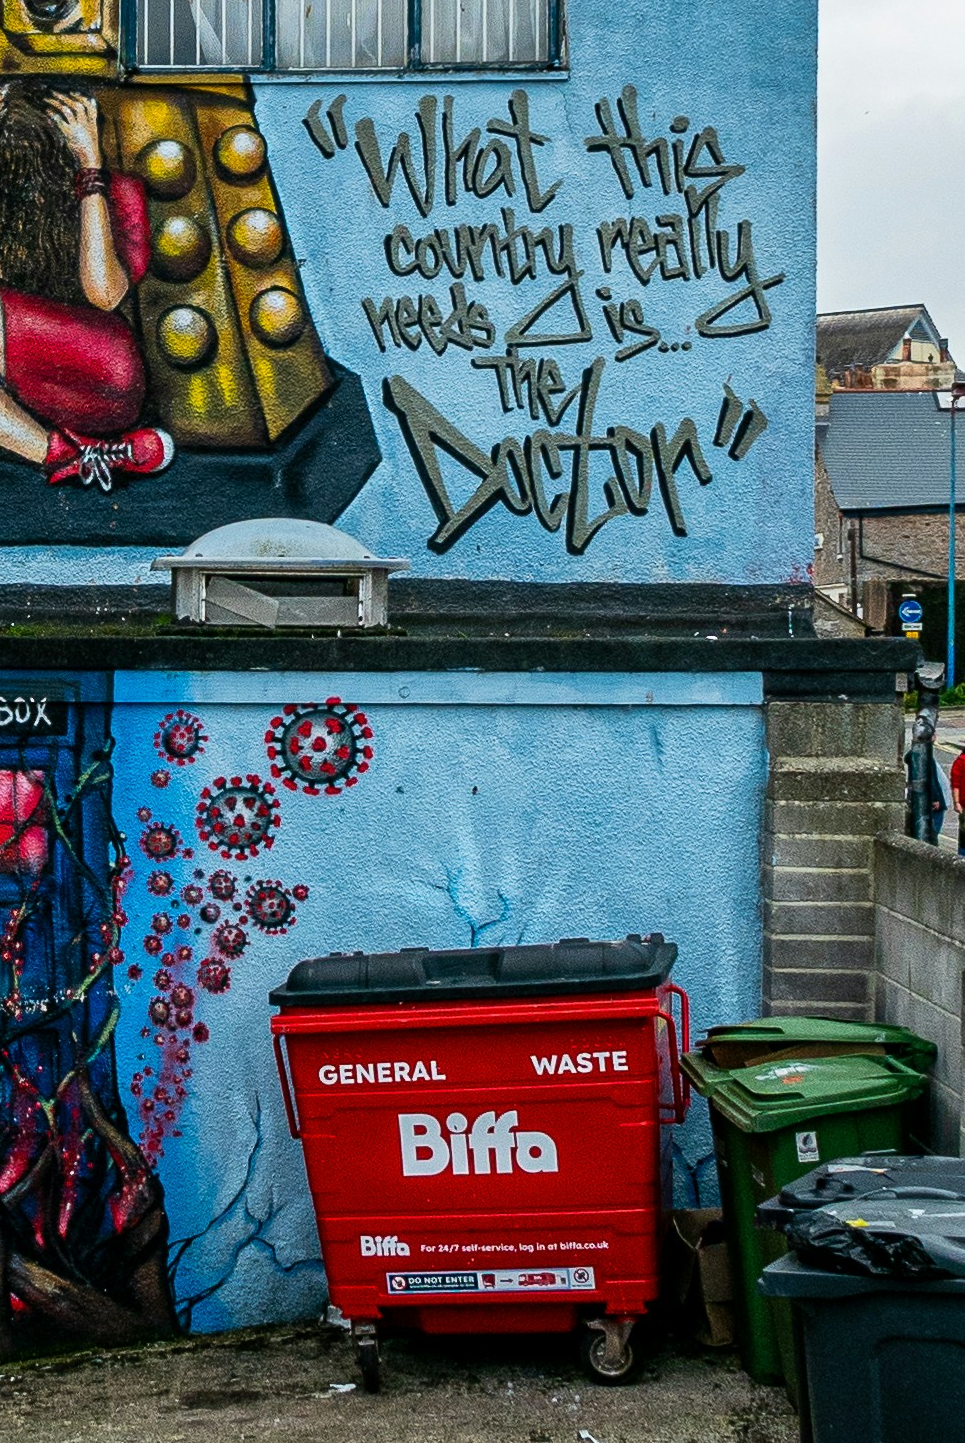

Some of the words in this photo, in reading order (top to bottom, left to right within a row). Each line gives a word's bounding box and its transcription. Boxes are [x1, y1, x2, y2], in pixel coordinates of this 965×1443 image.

[584, 85, 746, 201] this
[384, 208, 592, 348] country
[596, 194, 785, 338] really
[362, 283, 496, 355] needs
[318, 1060, 447, 1085] GENERAL
[530, 1050, 629, 1075] WASTE
[398, 1110, 559, 1176] Biffa
[360, 1235, 411, 1256] Biffa
[420, 1244, 436, 1253] For
[438, 1244, 459, 1253] 24/7
[461, 1243, 517, 1253] self-service,
[519, 1243, 534, 1253] log
[536, 1242, 546, 1251] in
[547, 1243, 558, 1251] at
[559, 1241, 609, 1250] biffa.co.uk
[408, 1277, 422, 1285] DO
[424, 1276, 443, 1284] NOT
[445, 1275, 475, 1283] ENTER
